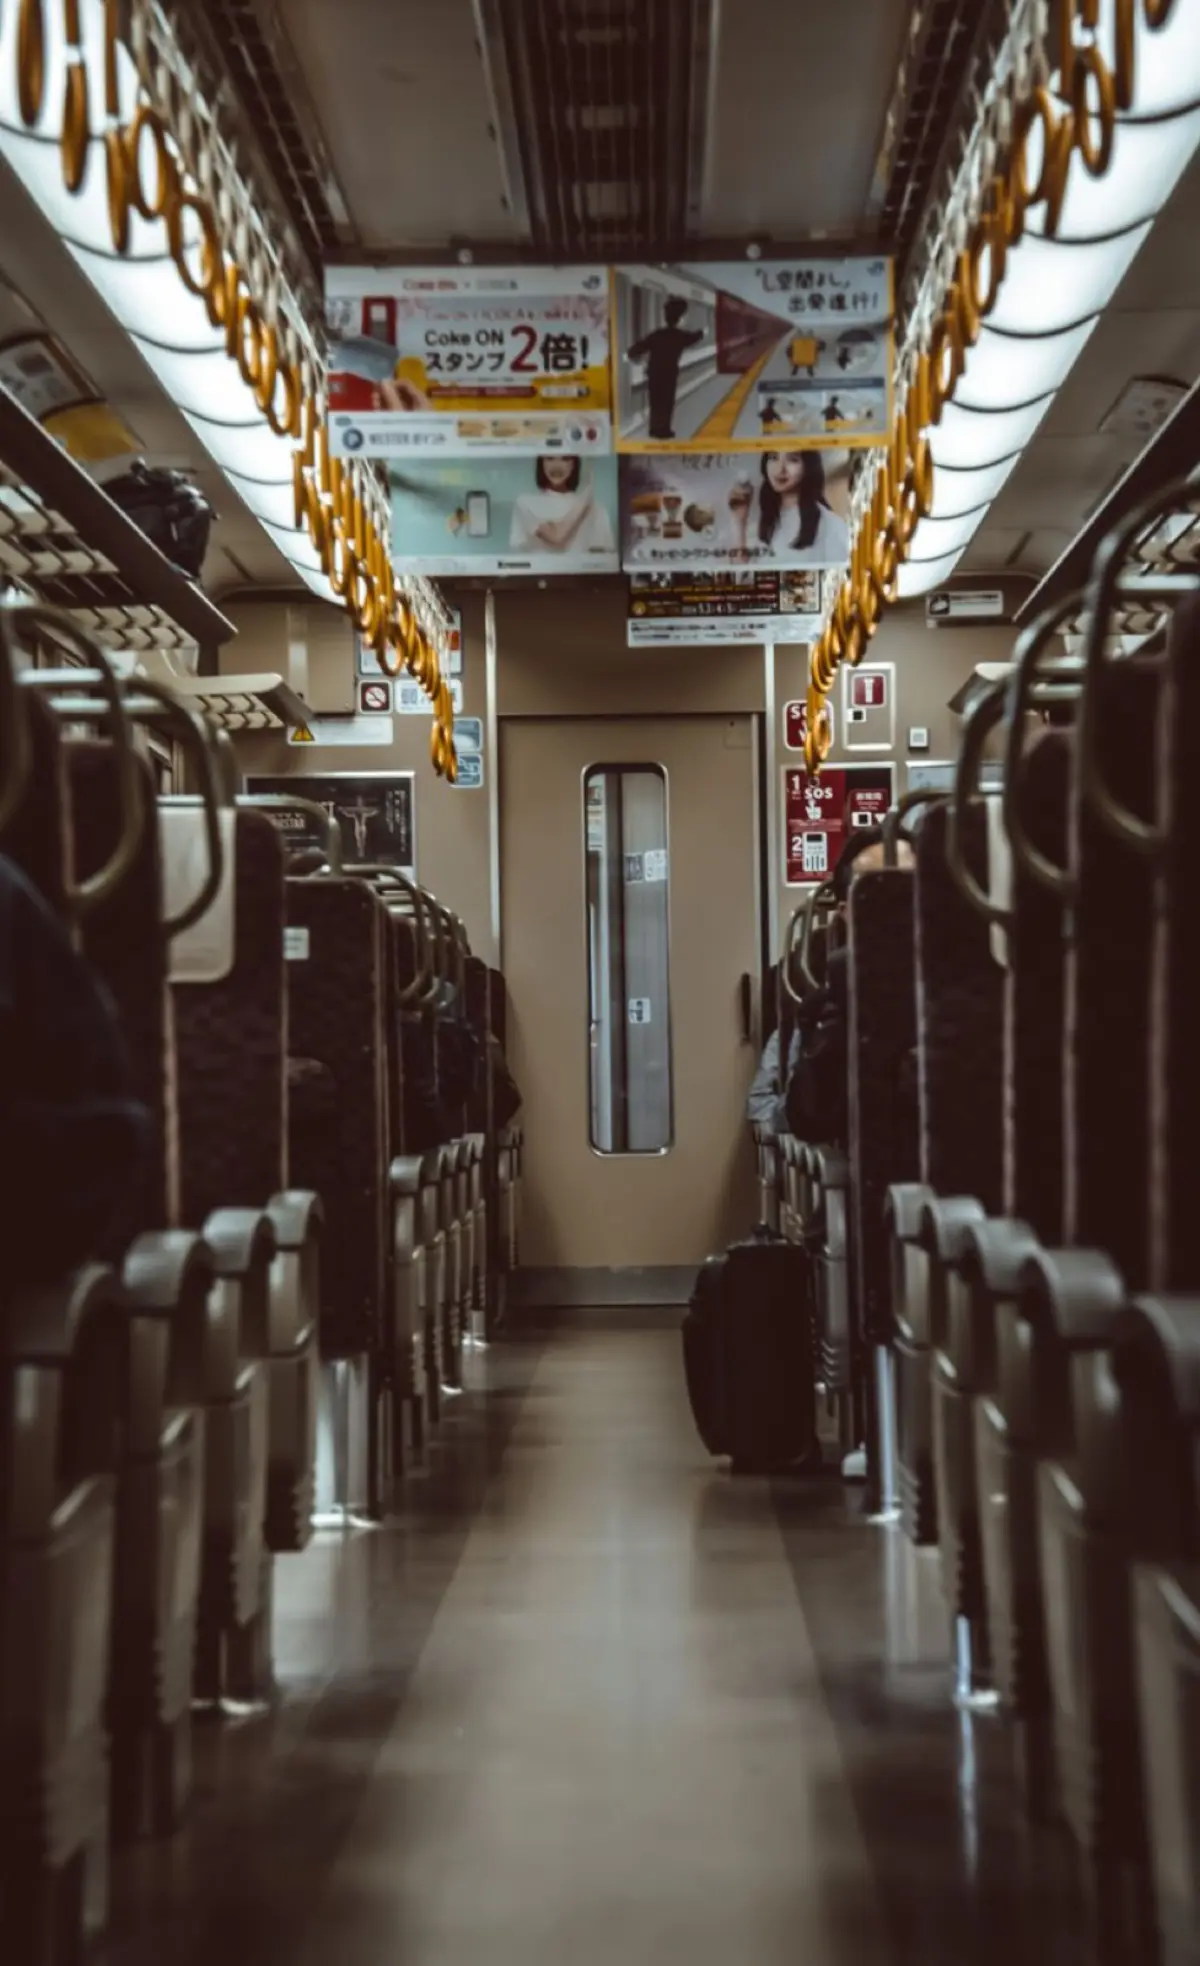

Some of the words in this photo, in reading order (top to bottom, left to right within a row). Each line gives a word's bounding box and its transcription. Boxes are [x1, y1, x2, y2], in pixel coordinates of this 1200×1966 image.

[424, 330, 472, 347] Coke
[475, 330, 505, 346] ON
[425, 352, 506, 373] スタンプ
[791, 774, 801, 791] 1
[804, 787, 834, 800] SOS
[791, 836, 802, 852] 2
